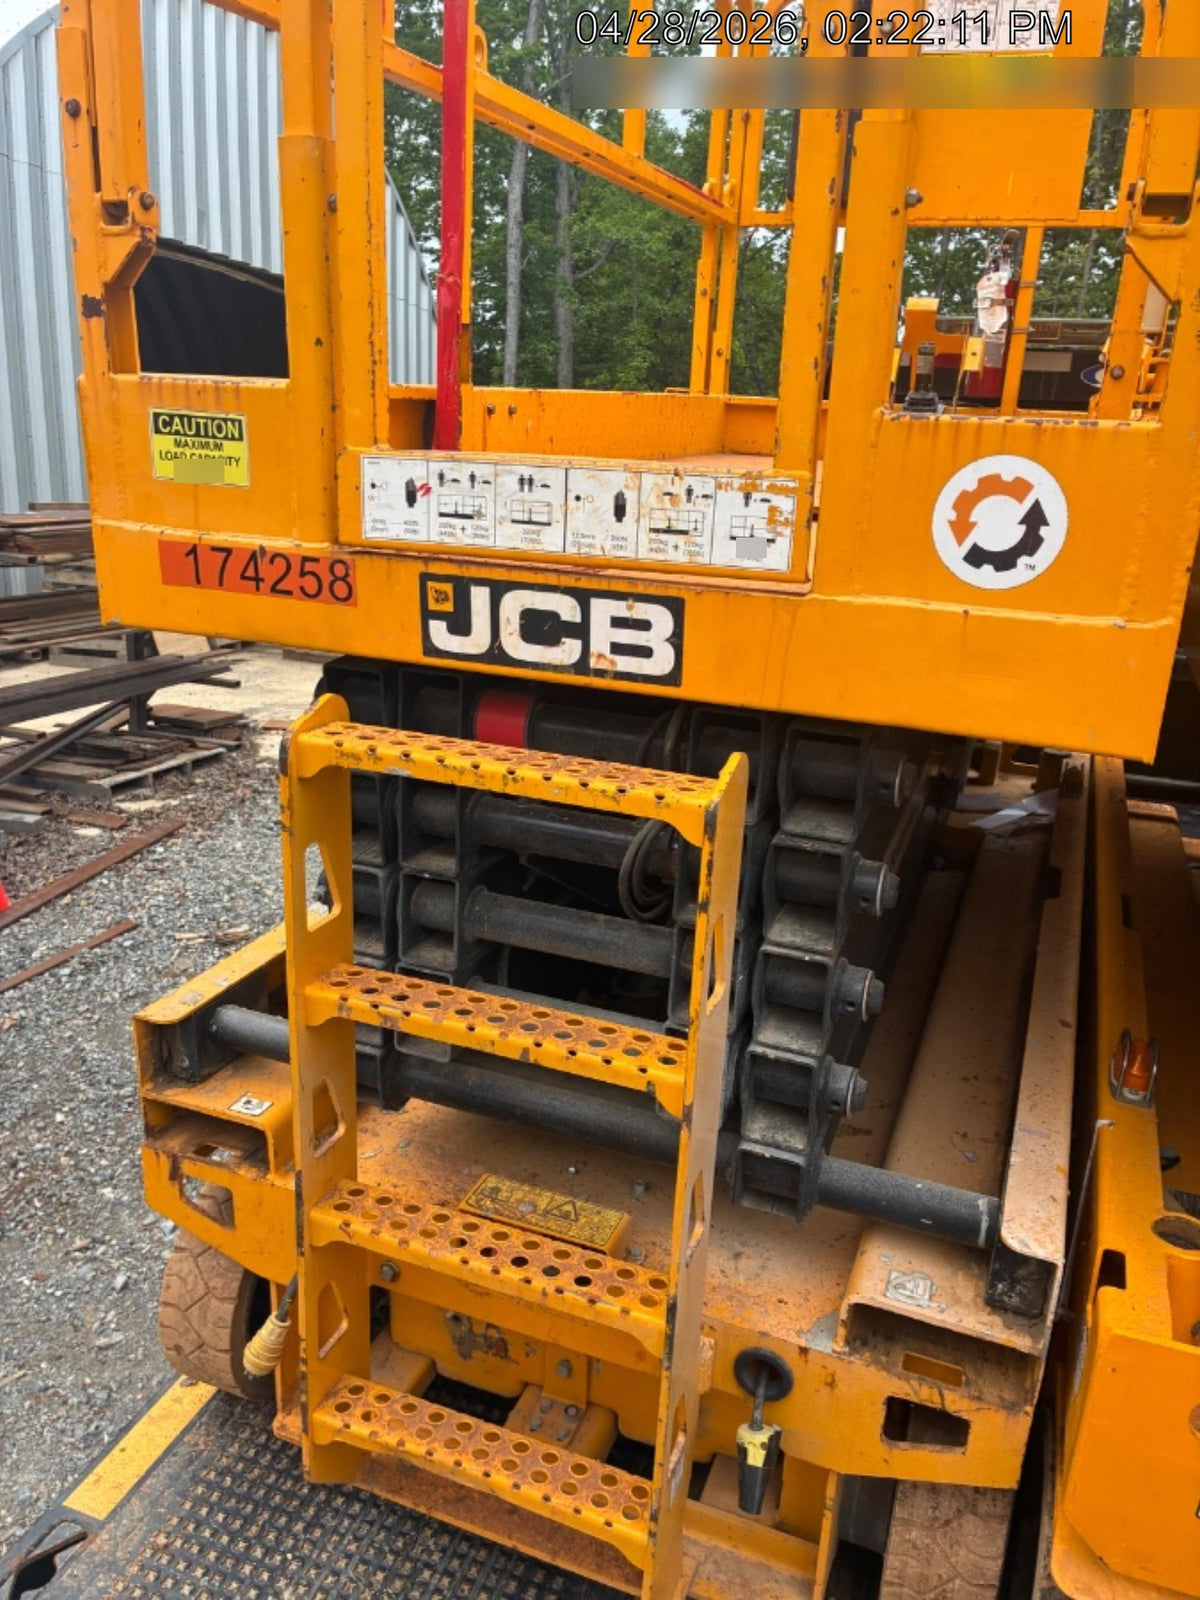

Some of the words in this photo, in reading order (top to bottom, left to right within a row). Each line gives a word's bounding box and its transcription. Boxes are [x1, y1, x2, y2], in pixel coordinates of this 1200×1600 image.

[158, 414, 240, 439] CAUTION
[173, 437, 224, 452] MAXIMUM
[184, 543, 354, 603] 174258
[428, 585, 676, 677] JCB
